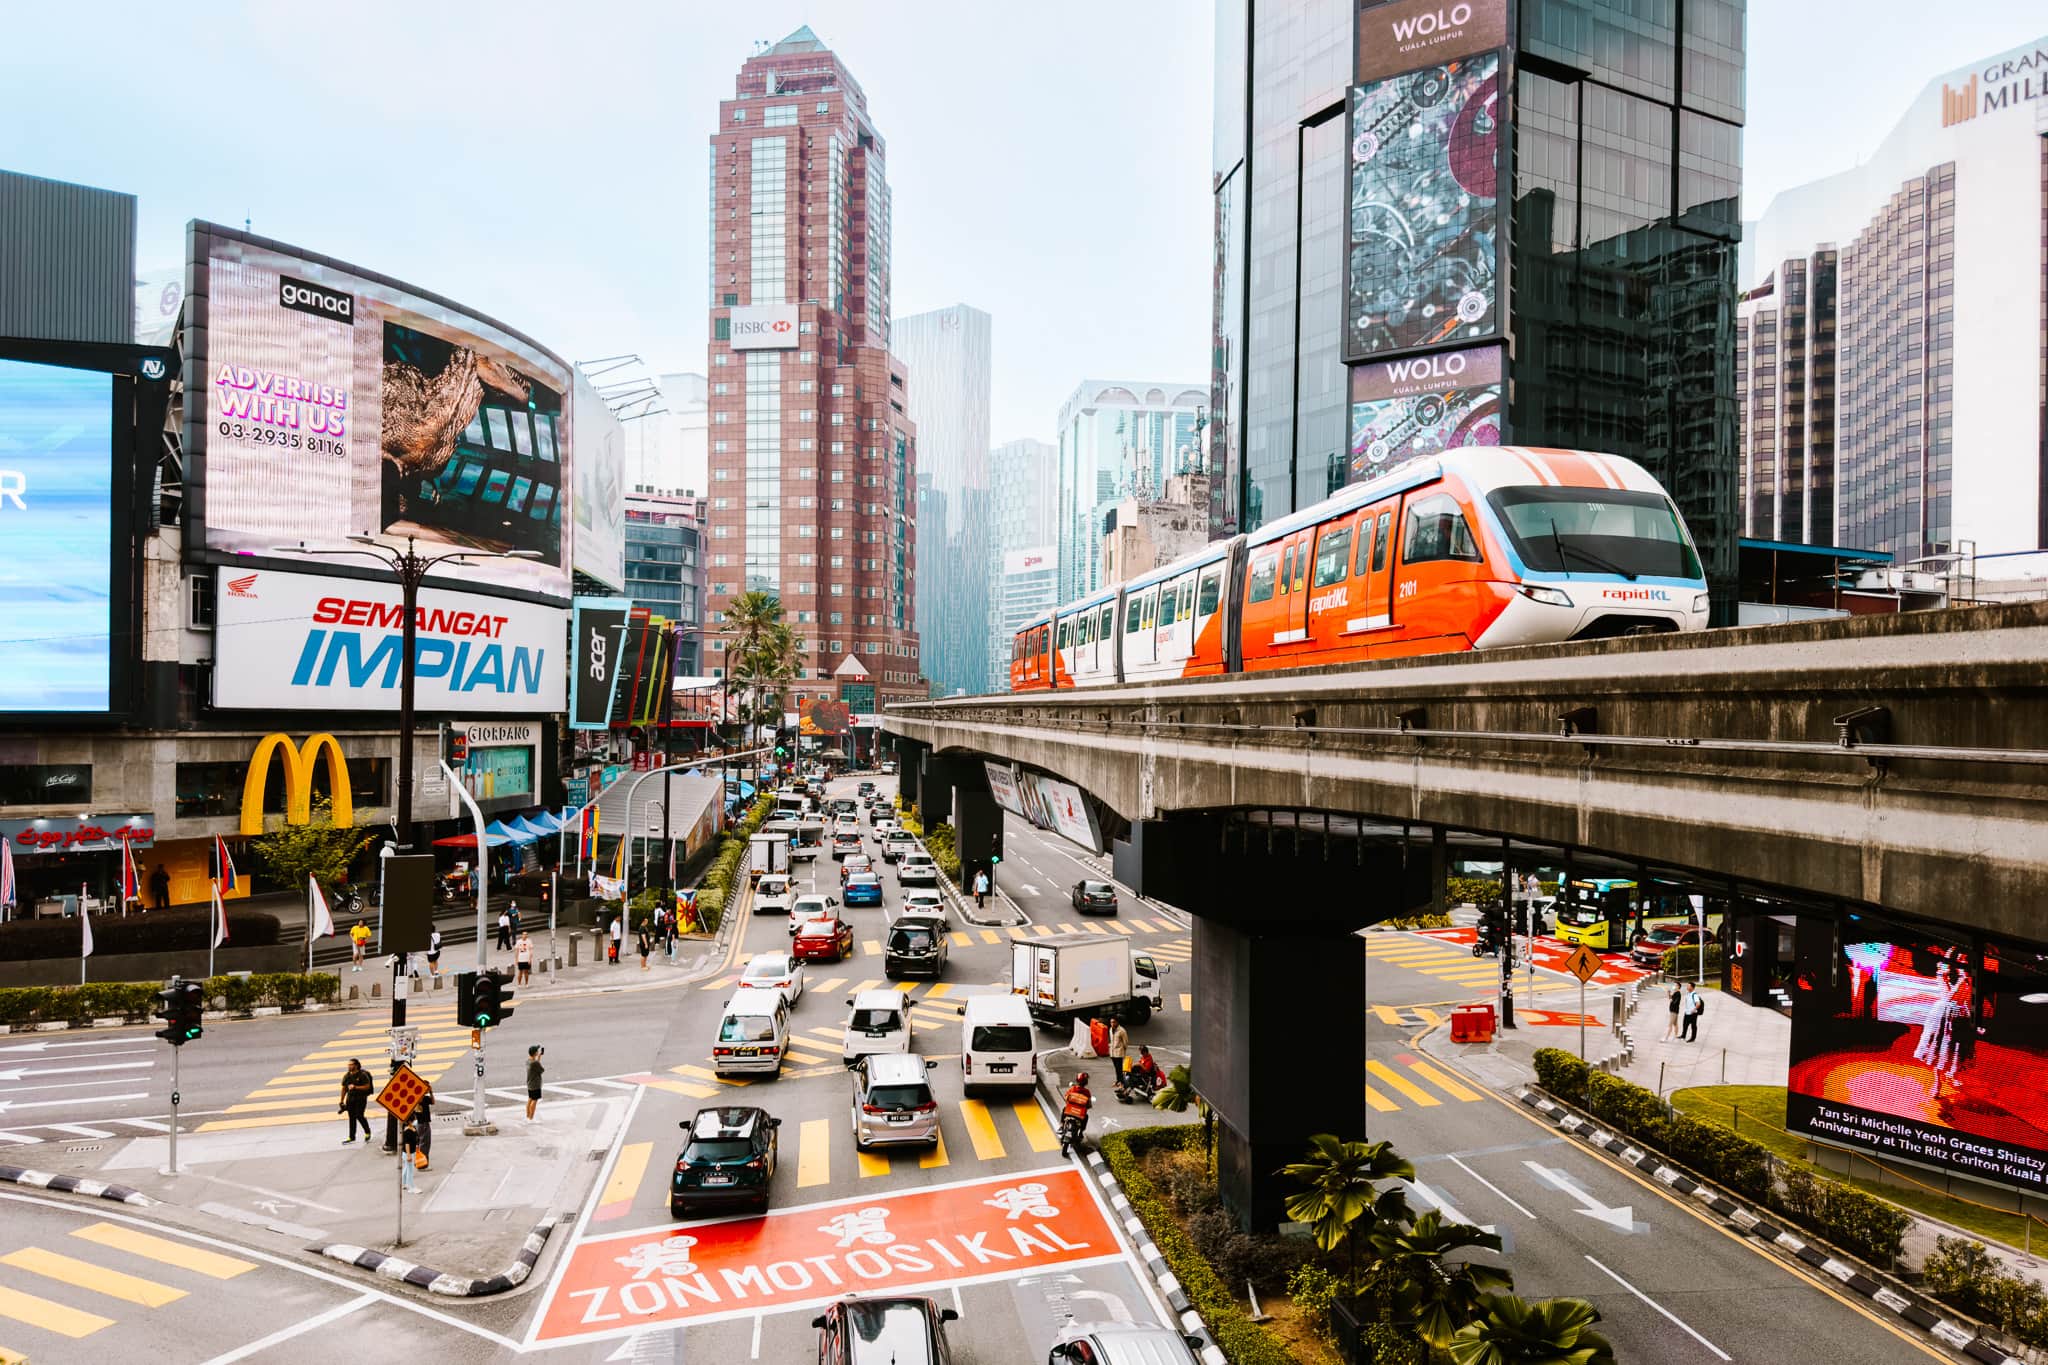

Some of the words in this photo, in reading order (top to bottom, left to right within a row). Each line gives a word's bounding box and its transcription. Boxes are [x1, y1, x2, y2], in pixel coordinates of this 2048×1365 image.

[1392, 4, 1472, 42] WOLO
[1400, 42, 1427, 53] KUALA
[1429, 31, 1464, 46] LUMPUR
[282, 284, 350, 316] ganad
[734, 320, 770, 334] HSBC
[1386, 354, 1466, 383] WOLO
[216, 364, 346, 410] ADVERTISE
[1393, 386, 1420, 395] KUALA
[1424, 380, 1458, 391] LUMPUR
[216, 388, 300, 428] WITH
[308, 405, 345, 437] US
[219, 421, 301, 449] 03-2935
[307, 437, 345, 457] 8116
[227, 591, 258, 599] HONDA
[1309, 586, 1348, 616] rapidKL
[1400, 580, 1417, 598] 2101
[1603, 589, 1671, 601] rapidKL
[291, 629, 544, 694] IMPIAN
[590, 627, 606, 681] acer
[468, 725, 530, 744] GIORDANO
[1809, 1117, 1880, 1145] Anniversary
[1883, 1137, 1896, 1147] at
[1899, 1139, 1922, 1153] The
[1925, 1145, 1948, 1160] Ritz
[1952, 1152, 2000, 1173] Carlton
[2003, 1164, 2041, 1183] Kuala
[1818, 1106, 1840, 1120] Tan
[1843, 1112, 1858, 1124] Sri
[1861, 1116, 1911, 1138] Michelle
[1915, 1129, 1946, 1145] Yeoh
[1950, 1138, 1994, 1157] Graces
[1997, 1149, 2046, 1172] Shiatzy
[569, 1273, 722, 1324] ZON
[718, 1223, 1091, 1299] MOTOSIKAL
